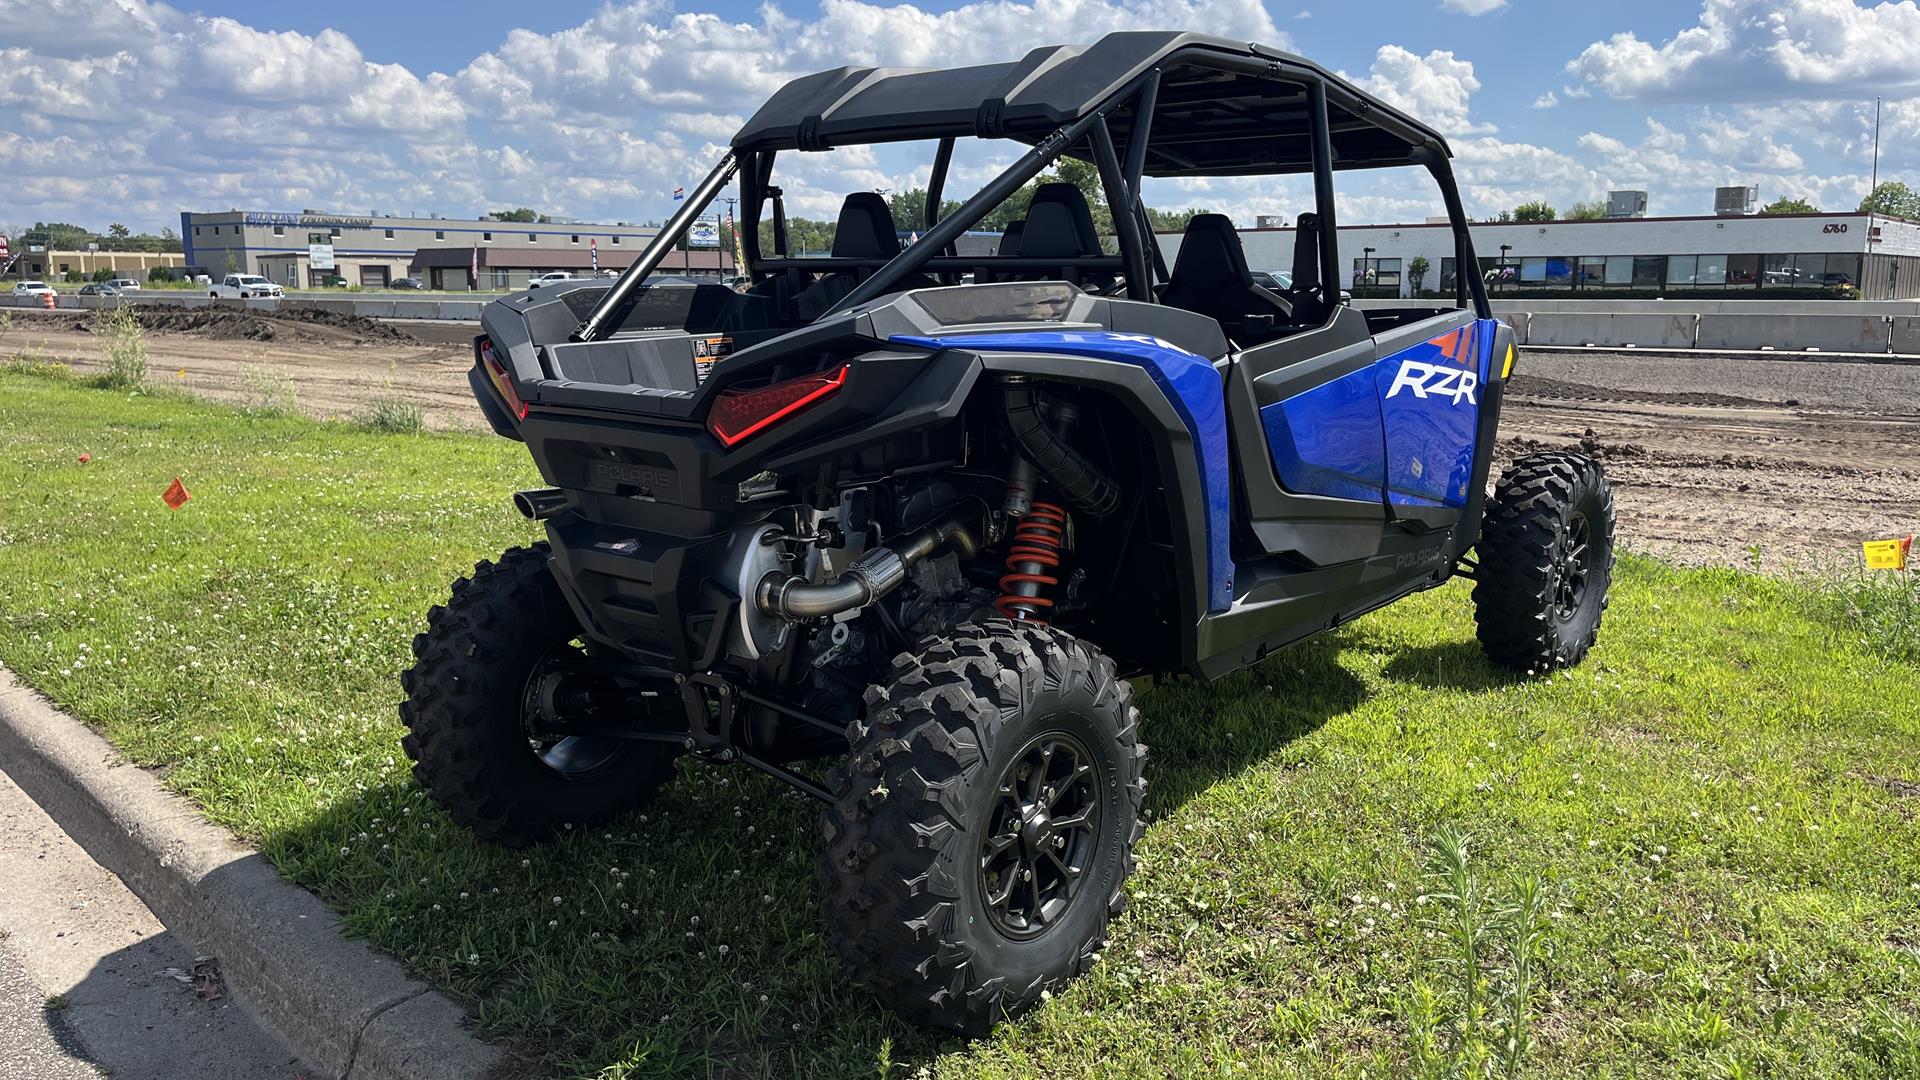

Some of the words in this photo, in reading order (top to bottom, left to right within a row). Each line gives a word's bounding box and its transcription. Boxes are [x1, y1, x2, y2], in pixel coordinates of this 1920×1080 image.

[691, 225, 719, 235] DIAMOND
[1823, 224, 1847, 233] 6760
[1385, 359, 1478, 406] RZR
[596, 464, 672, 488] POLARIS
[1396, 545, 1440, 570] POLARIS
